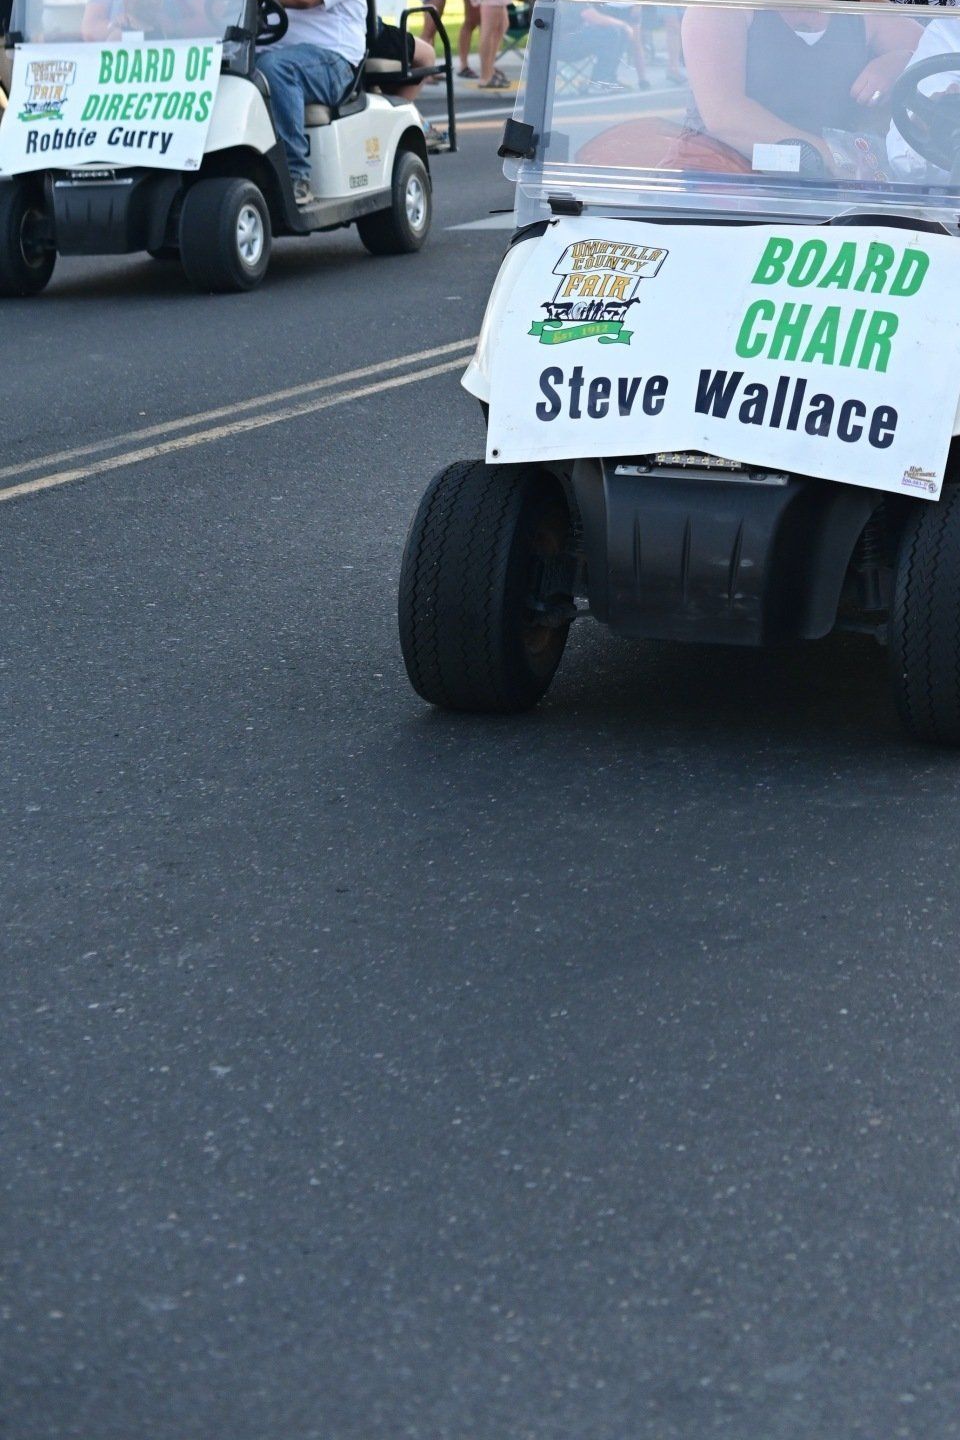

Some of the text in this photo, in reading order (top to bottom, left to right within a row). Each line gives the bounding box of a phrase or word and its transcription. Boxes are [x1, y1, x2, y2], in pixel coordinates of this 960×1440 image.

[98, 46, 214, 84] BOARD OF
[80, 91, 213, 123] DIRECTORS
[26, 126, 173, 154] Robbie Curry
[571, 241, 663, 261] UMATILLA
[572, 255, 649, 273] COUNTY
[751, 237, 930, 298] BOARD
[561, 273, 634, 301] FAIR
[735, 299, 900, 373] CHAIR
[535, 365, 899, 449] Steve Wallace
